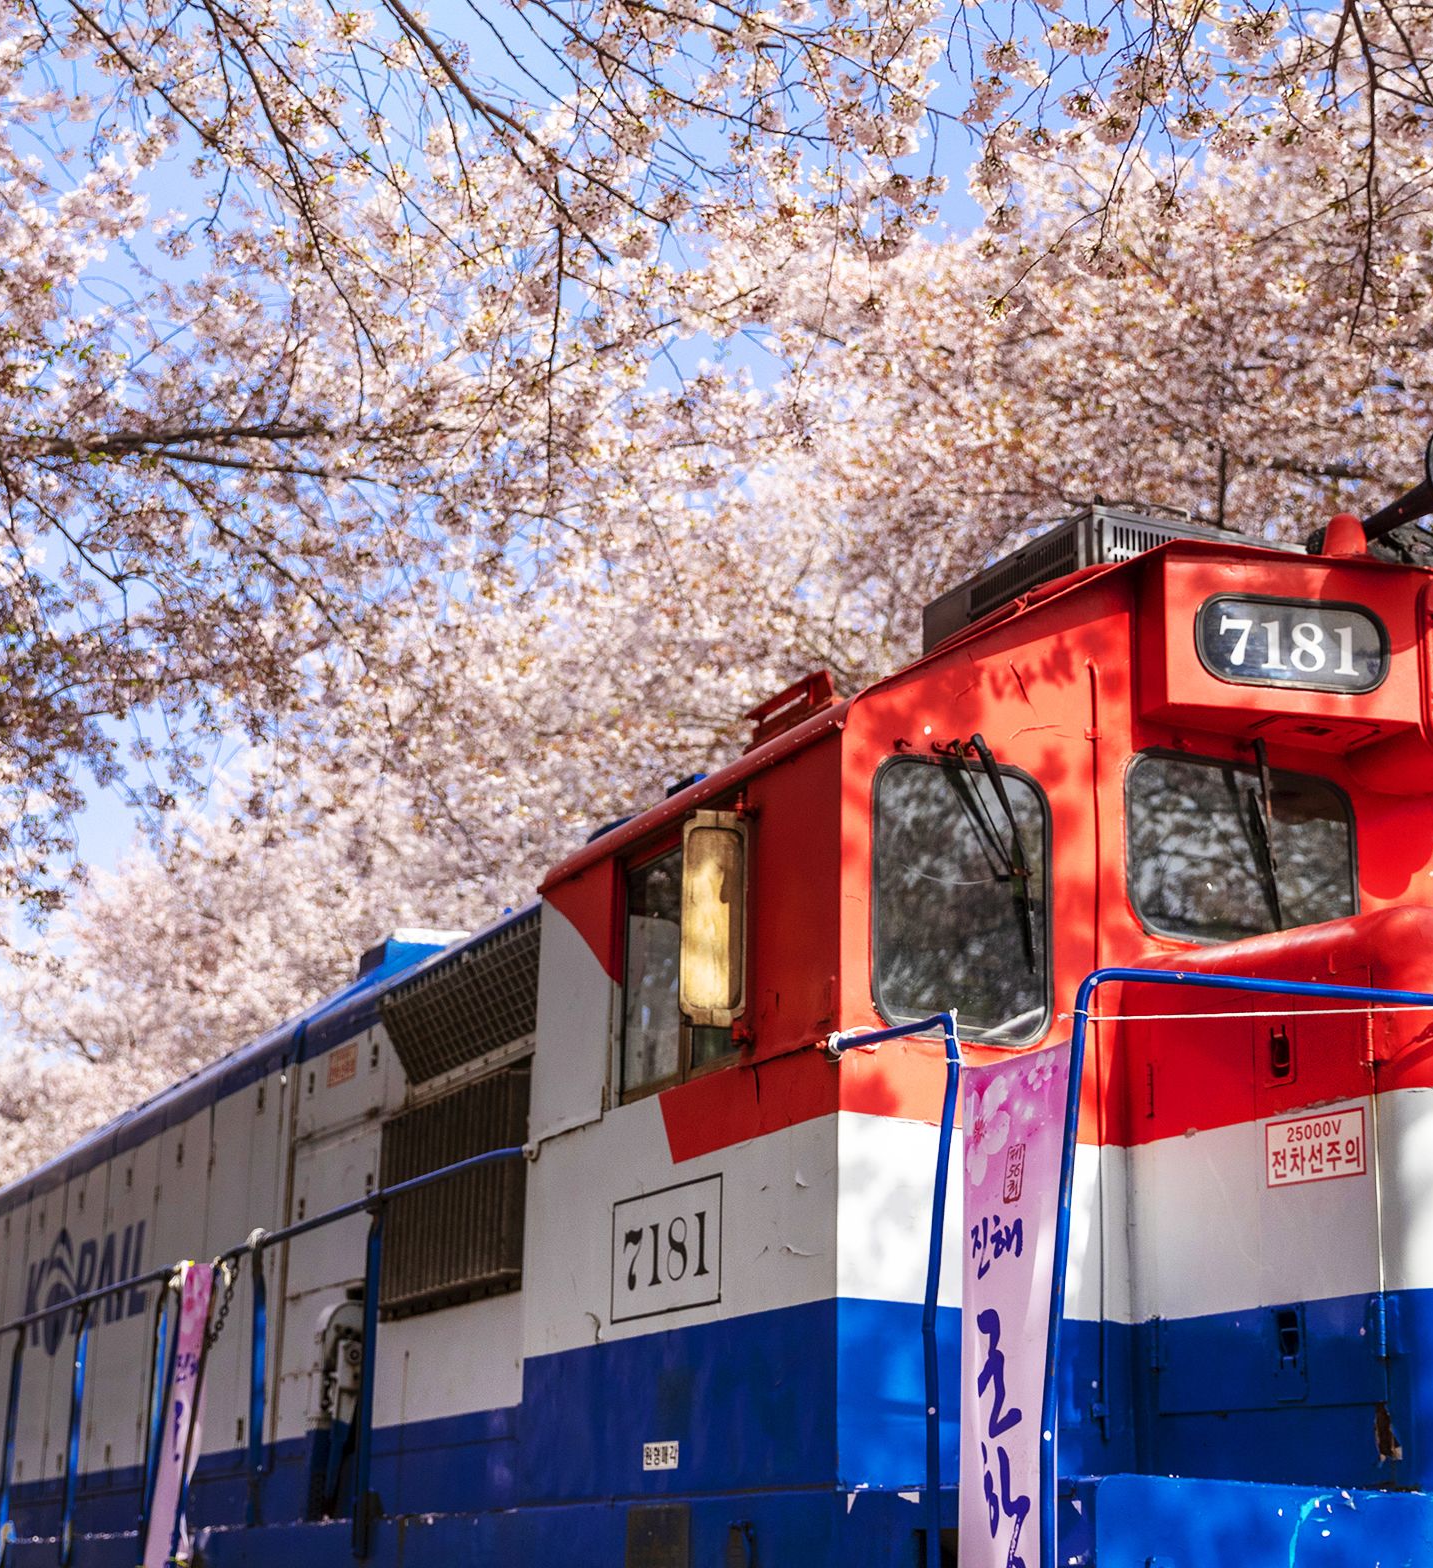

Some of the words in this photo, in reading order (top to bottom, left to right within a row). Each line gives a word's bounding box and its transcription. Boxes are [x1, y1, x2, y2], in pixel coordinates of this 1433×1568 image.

[1219, 615, 1360, 676] 7181
[1272, 1136, 1360, 1179] 전차선주의
[1287, 1119, 1341, 1142] 25000V
[623, 1210, 710, 1291] 7181
[970, 1214, 1024, 1280] 진해
[24, 1219, 146, 1356] KORAIL
